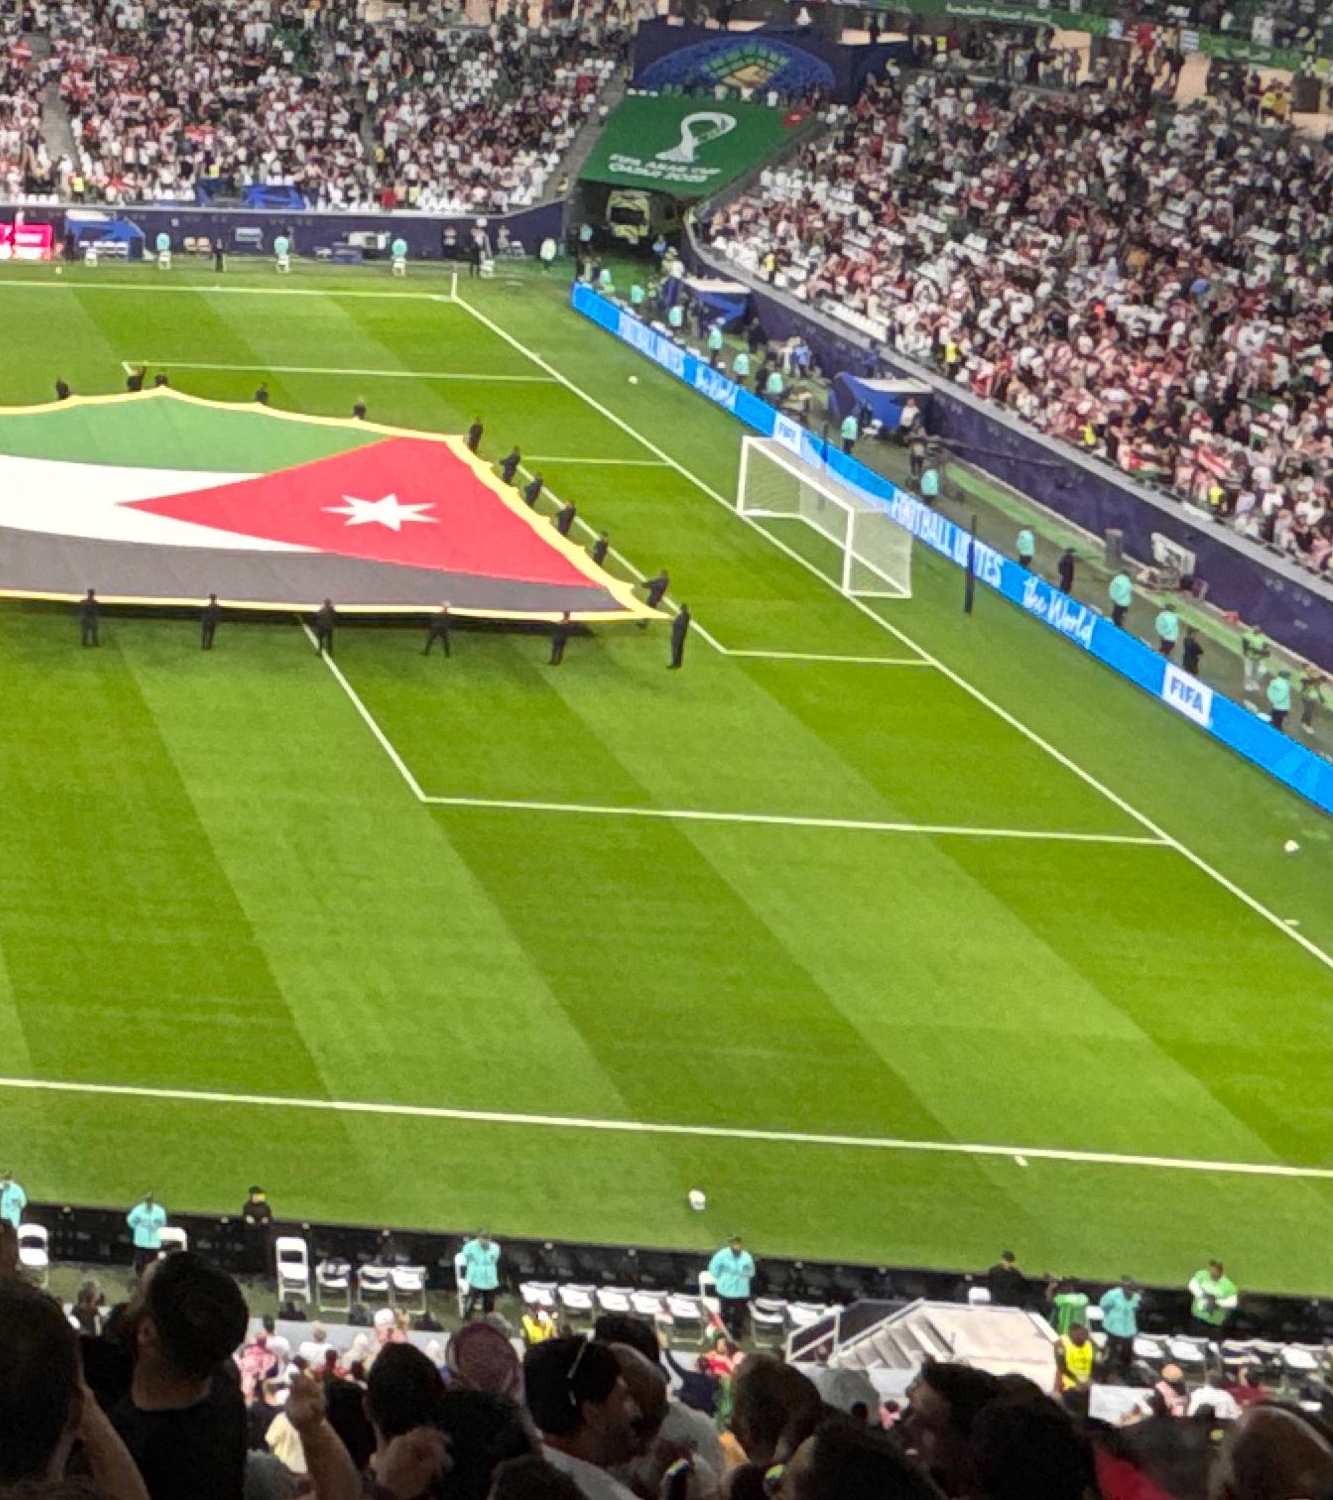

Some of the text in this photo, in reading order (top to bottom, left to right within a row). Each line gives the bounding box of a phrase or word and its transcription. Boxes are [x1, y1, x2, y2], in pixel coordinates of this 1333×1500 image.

[892, 487, 1005, 588] FOOTBALL UNTES
[1023, 576, 1097, 649] the World
[1170, 675, 1203, 714] FIFA
